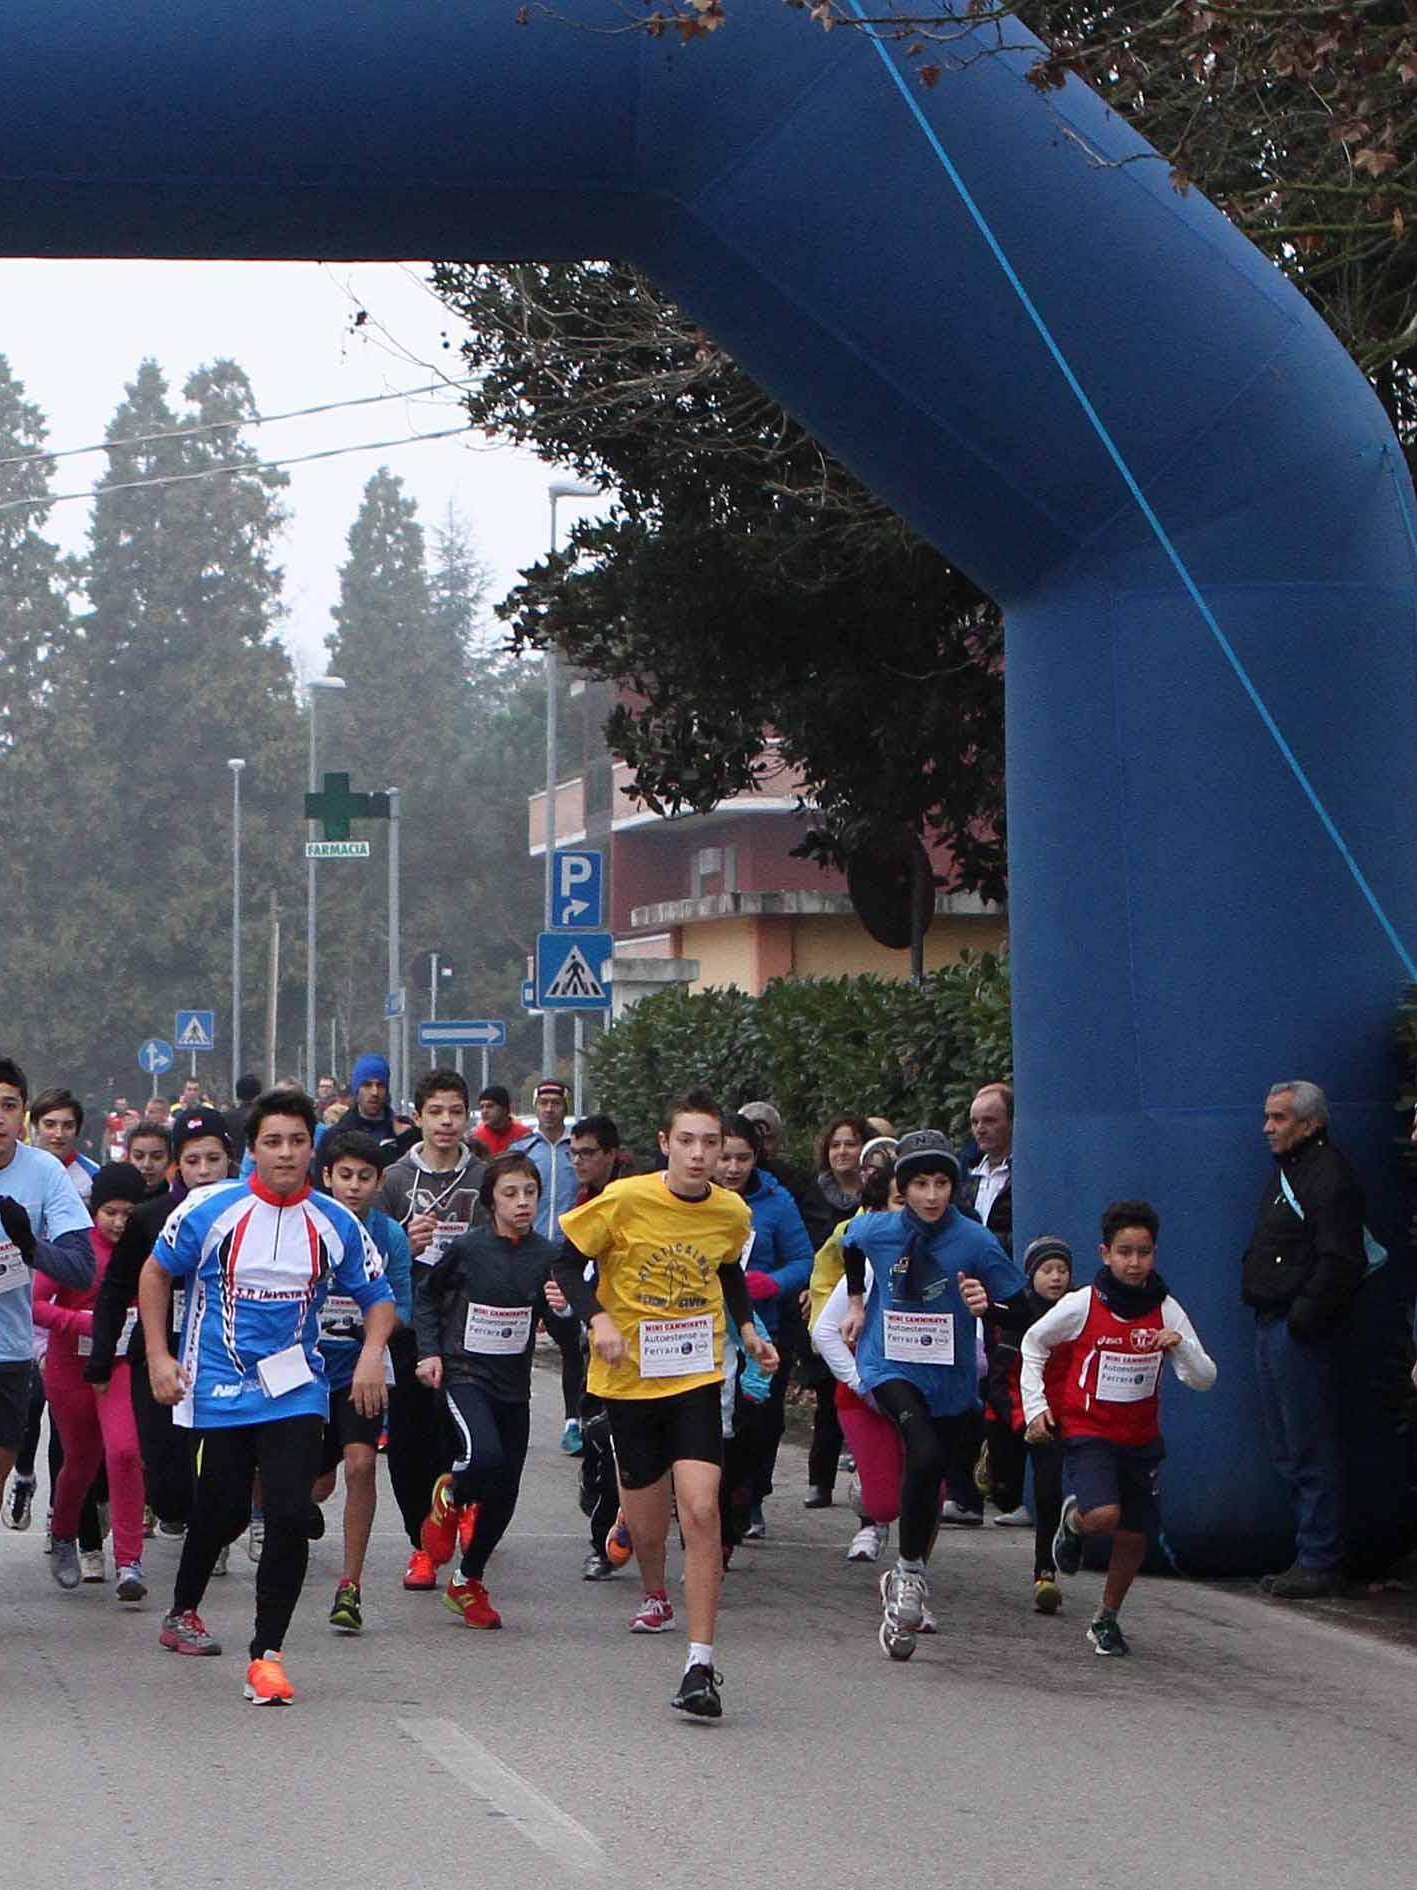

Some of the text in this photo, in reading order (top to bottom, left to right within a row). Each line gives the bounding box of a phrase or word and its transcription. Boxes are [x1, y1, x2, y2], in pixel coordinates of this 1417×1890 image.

[308, 844, 367, 854] FARMACIA
[561, 856, 592, 896] P
[644, 1332, 697, 1343] Autoestense
[644, 1346, 679, 1356] Ferrara
